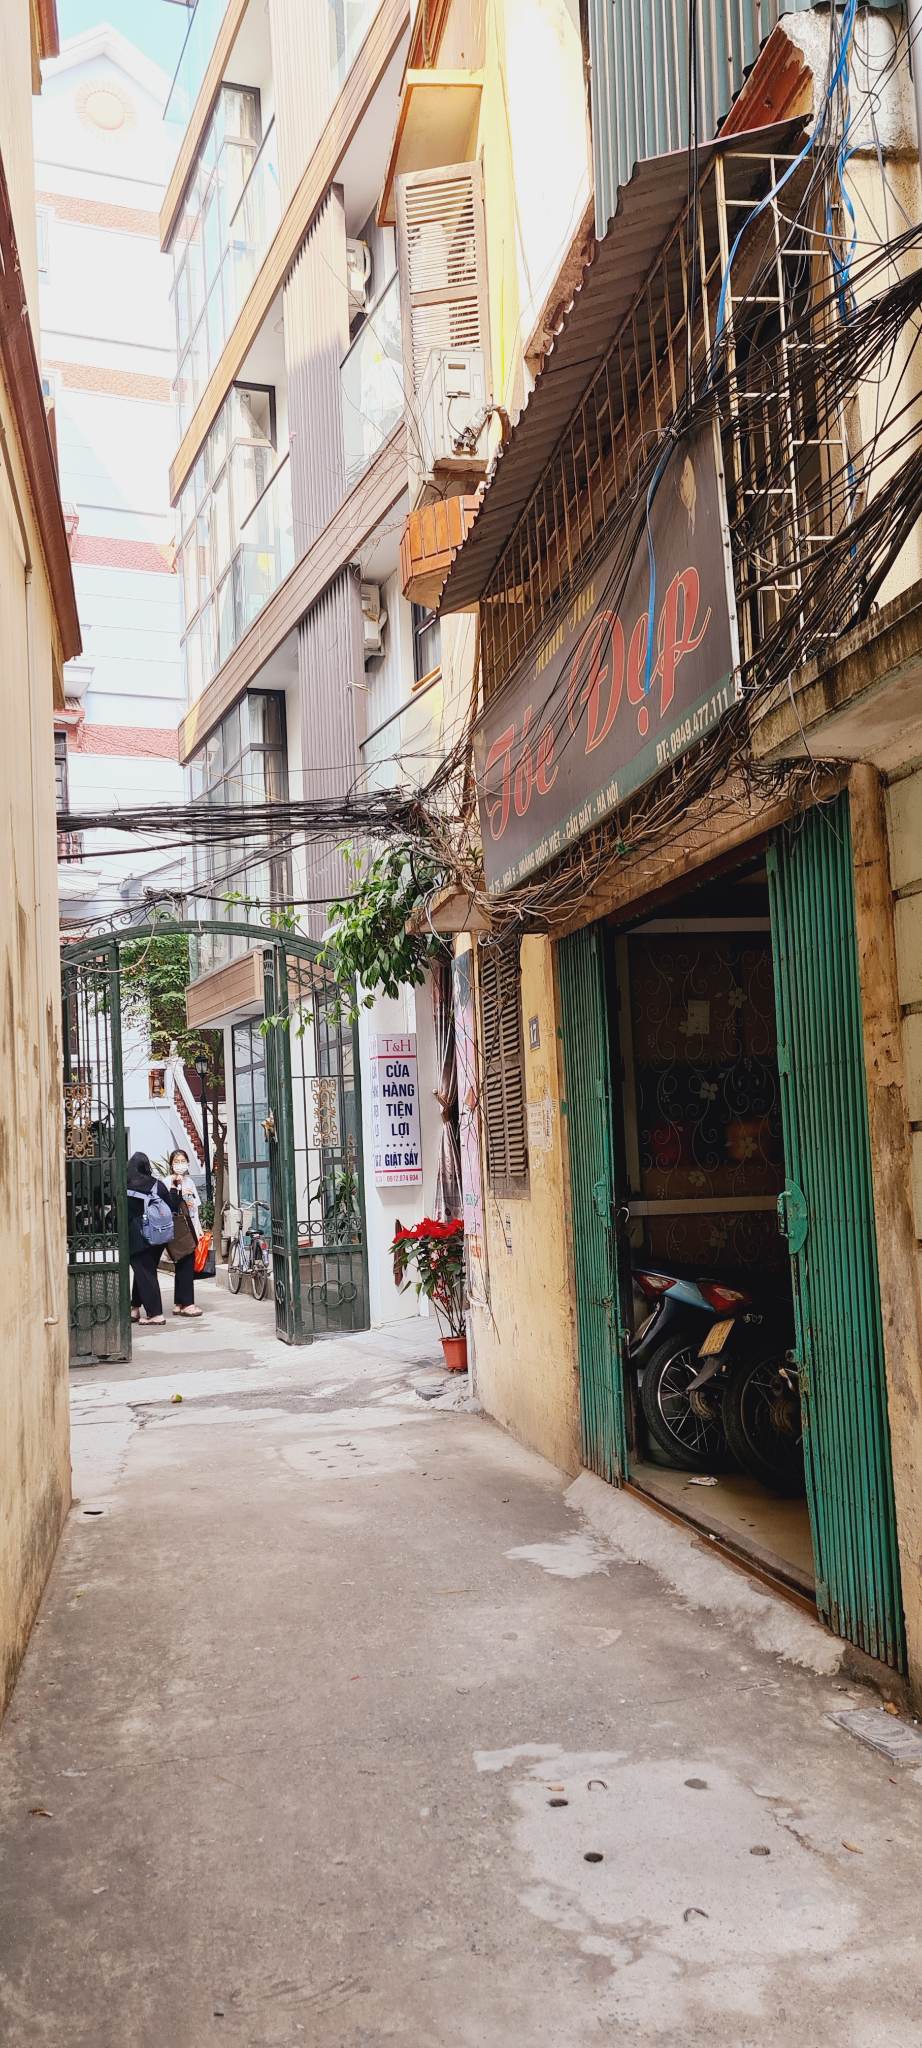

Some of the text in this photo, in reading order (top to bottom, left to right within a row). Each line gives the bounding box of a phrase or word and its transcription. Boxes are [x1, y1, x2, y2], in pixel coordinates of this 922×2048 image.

[567, 566, 712, 756] Đẹp
[670, 687, 729, 754] 0949.477.111
[596, 789, 607, 815] HÀ
[606, 779, 619, 807] NỘI
[382, 1039, 411, 1052] T&H
[385, 1060, 410, 1078] CỬA
[382, 1081, 415, 1097] HÀNG
[386, 1101, 413, 1119] TIỆN
[391, 1122, 410, 1138] LỢI
[384, 1148, 419, 1169] GIẶT SẤY
